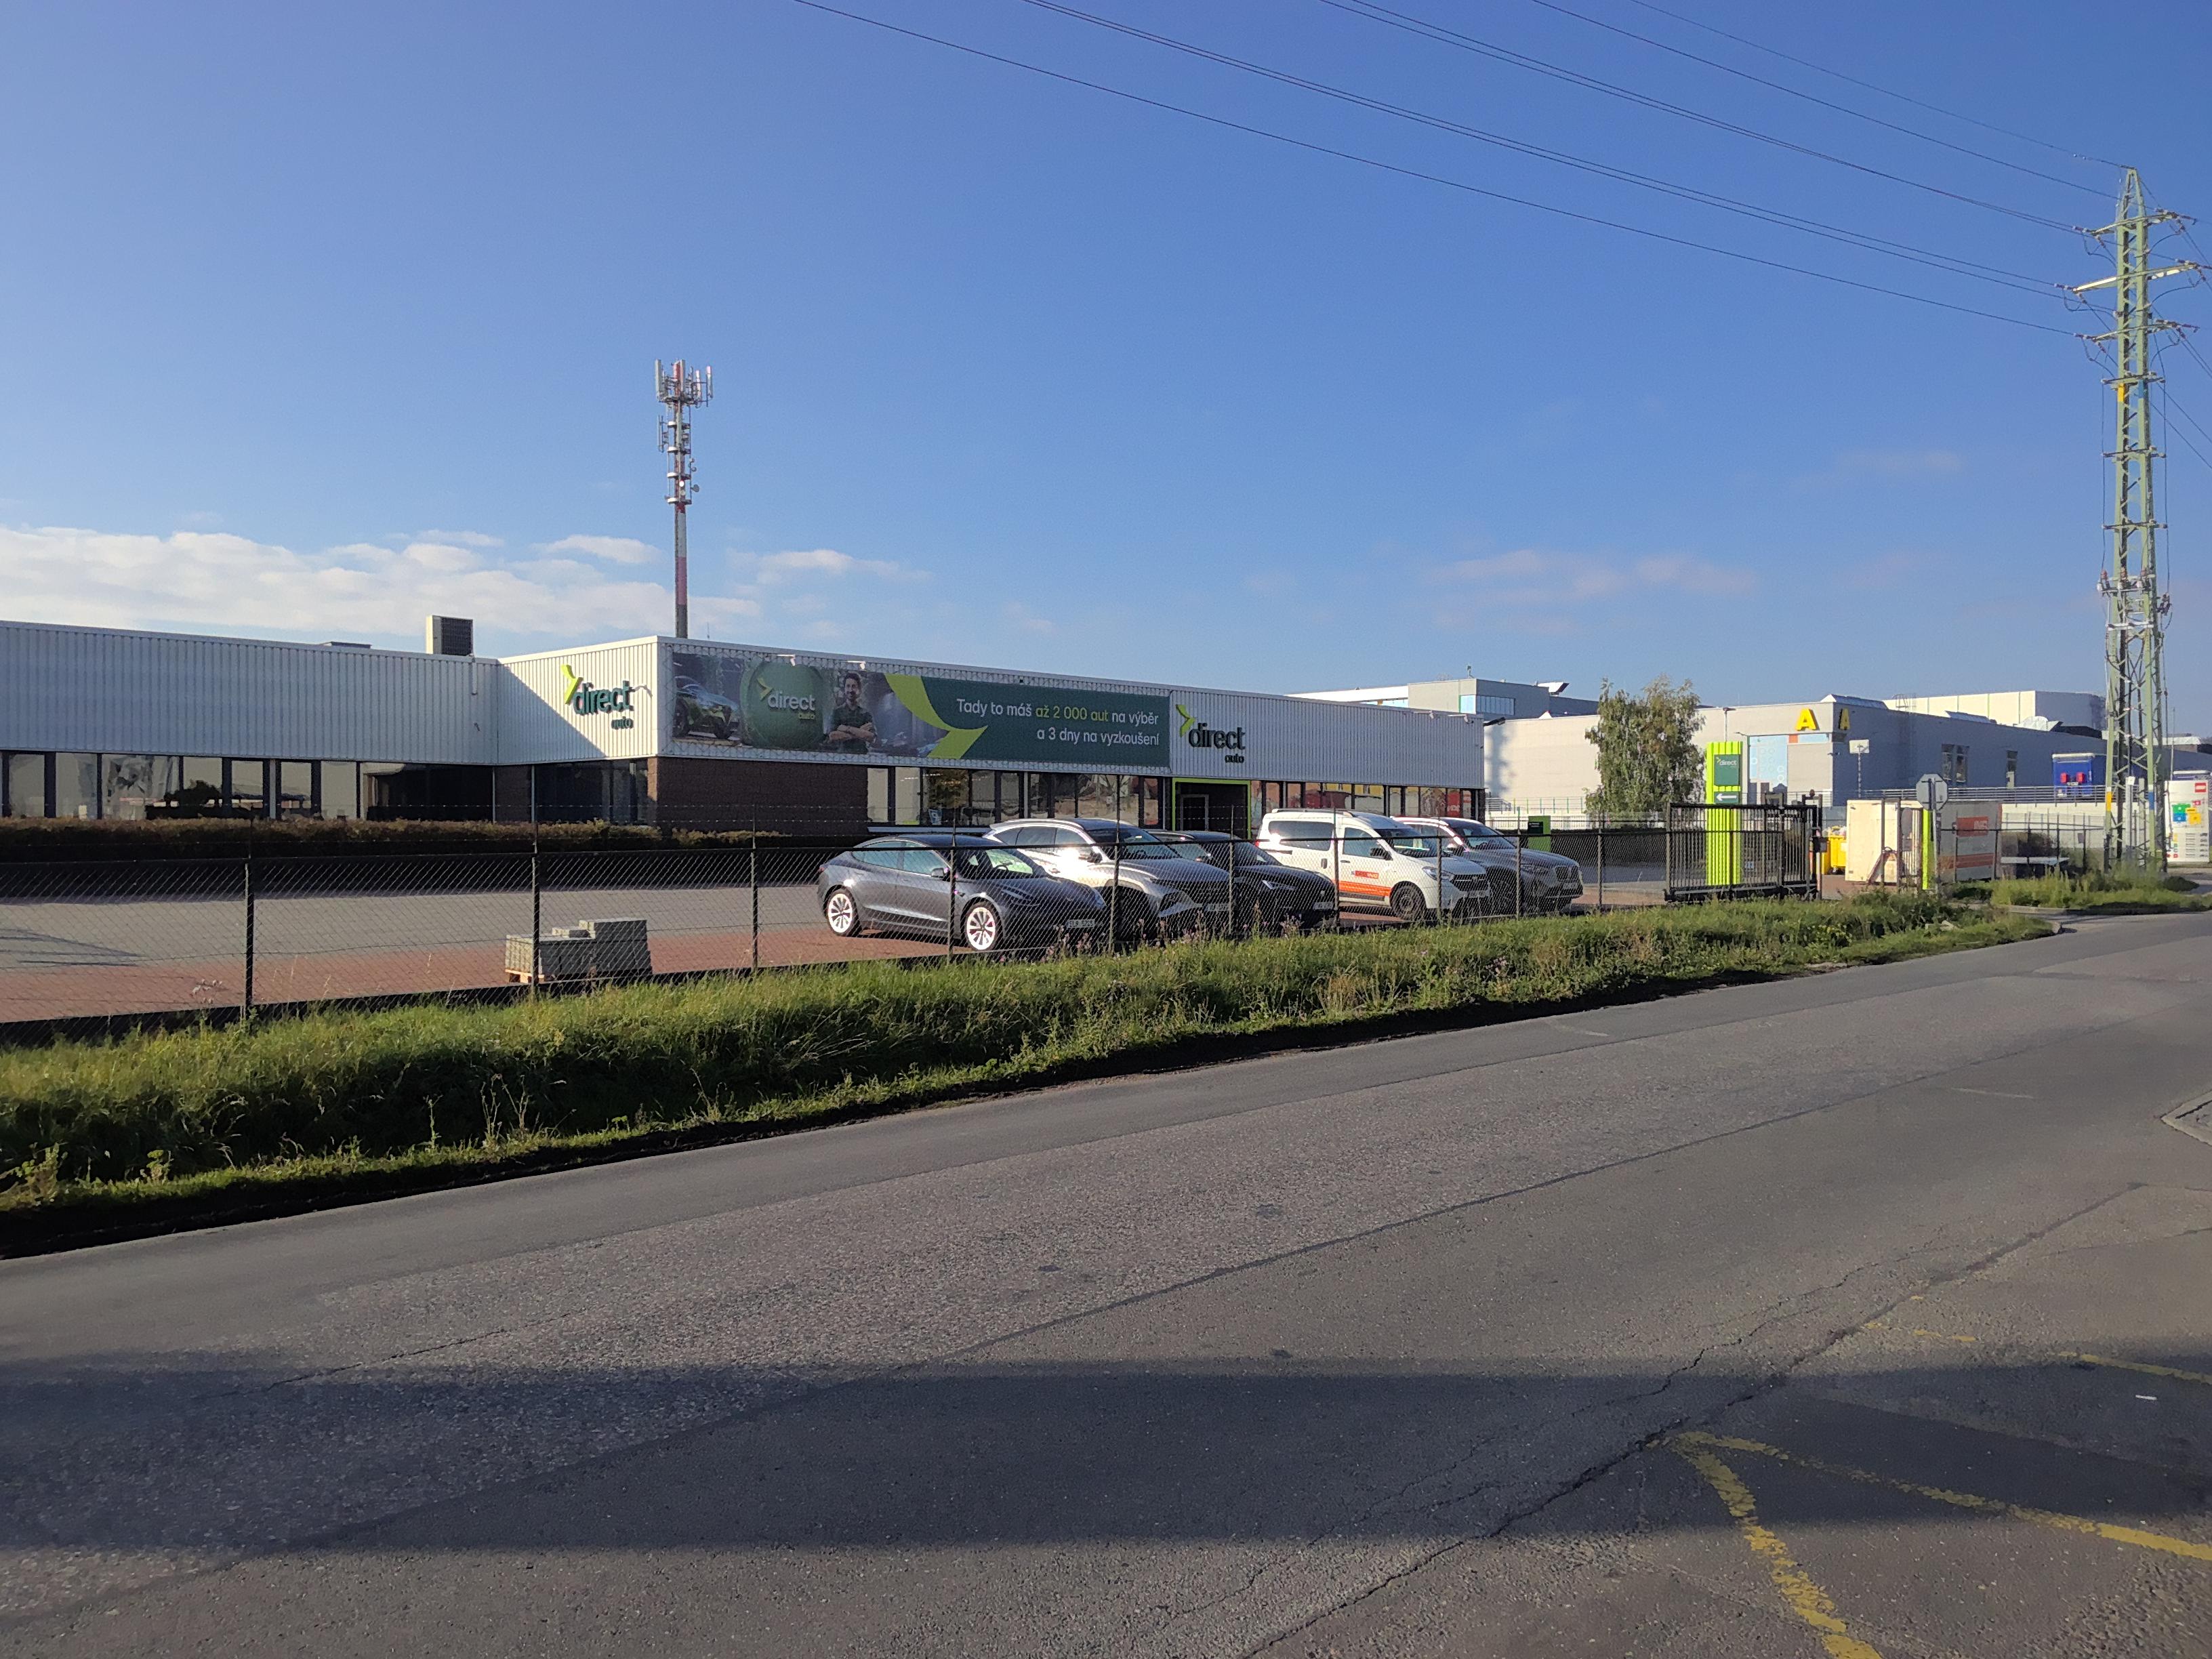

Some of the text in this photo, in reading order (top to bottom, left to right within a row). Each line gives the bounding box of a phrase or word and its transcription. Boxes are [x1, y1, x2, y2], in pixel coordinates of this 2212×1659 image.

[573, 680, 634, 716] direct
[768, 691, 815, 711] direct
[611, 716, 634, 730] auto
[956, 698, 1159, 726] Tady to máš až 2 000 aut na výběr
[1795, 708, 1819, 731] A
[1037, 726, 1160, 747] a 3 dny na vyzkoušení
[1189, 722, 1246, 750] direct
[1225, 753, 1244, 763] auto
